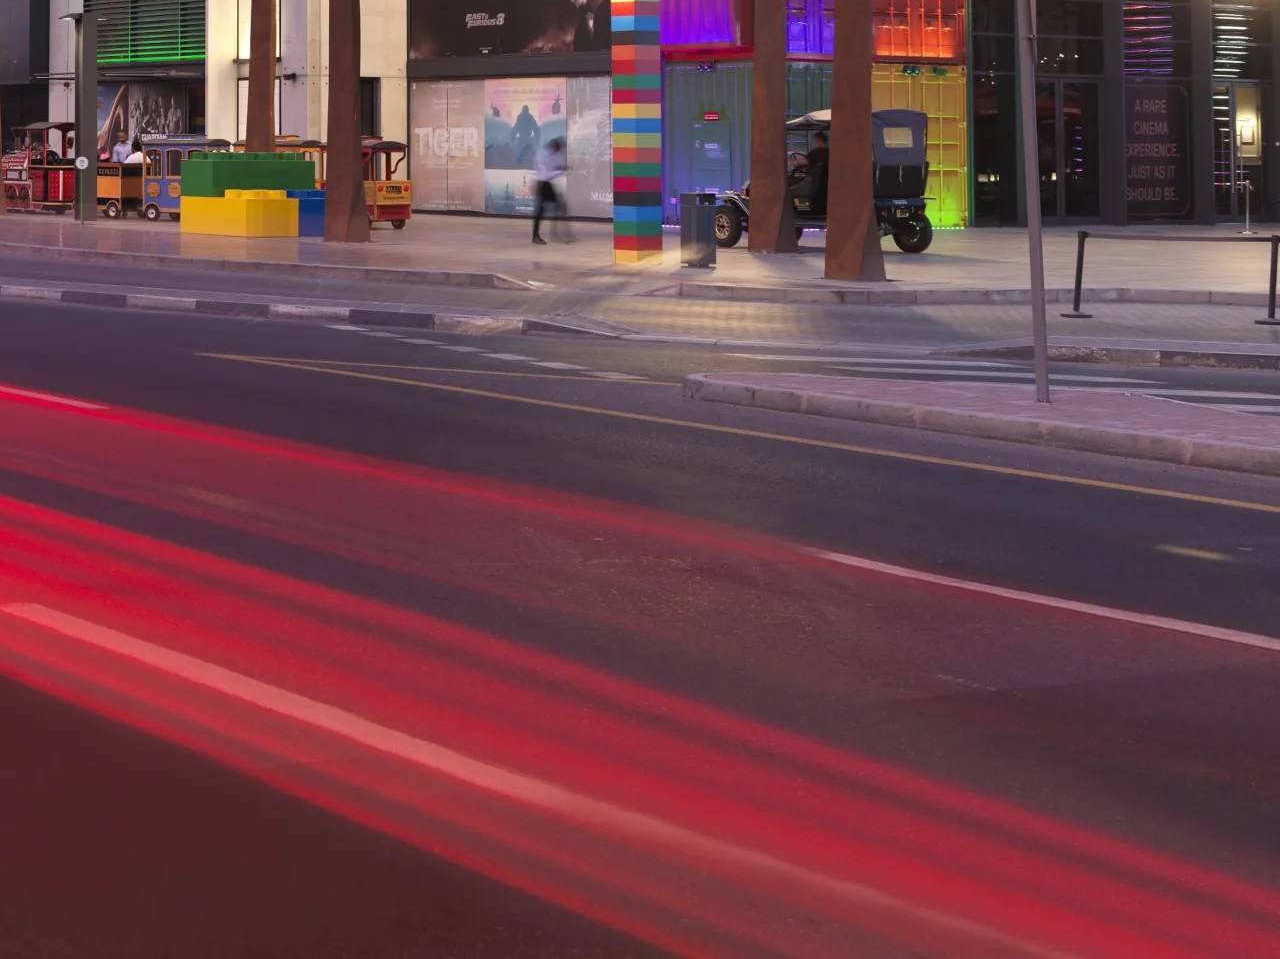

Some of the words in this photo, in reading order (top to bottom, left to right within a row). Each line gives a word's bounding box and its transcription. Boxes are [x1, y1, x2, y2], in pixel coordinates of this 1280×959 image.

[465, 13, 486, 22] FAST
[466, 18, 497, 29] FURIOUS
[495, 12, 505, 26] 8
[1134, 99, 1141, 113] A
[1142, 99, 1167, 113] RARE
[1133, 121, 1169, 135] CINEMA
[415, 127, 479, 158] TIGER
[1124, 143, 1180, 157] EXPERIENCE,
[1128, 165, 1151, 179] JUST
[1153, 165, 1166, 179] AS
[1167, 165, 1176, 179] IT
[1125, 187, 1162, 201] SHOULD
